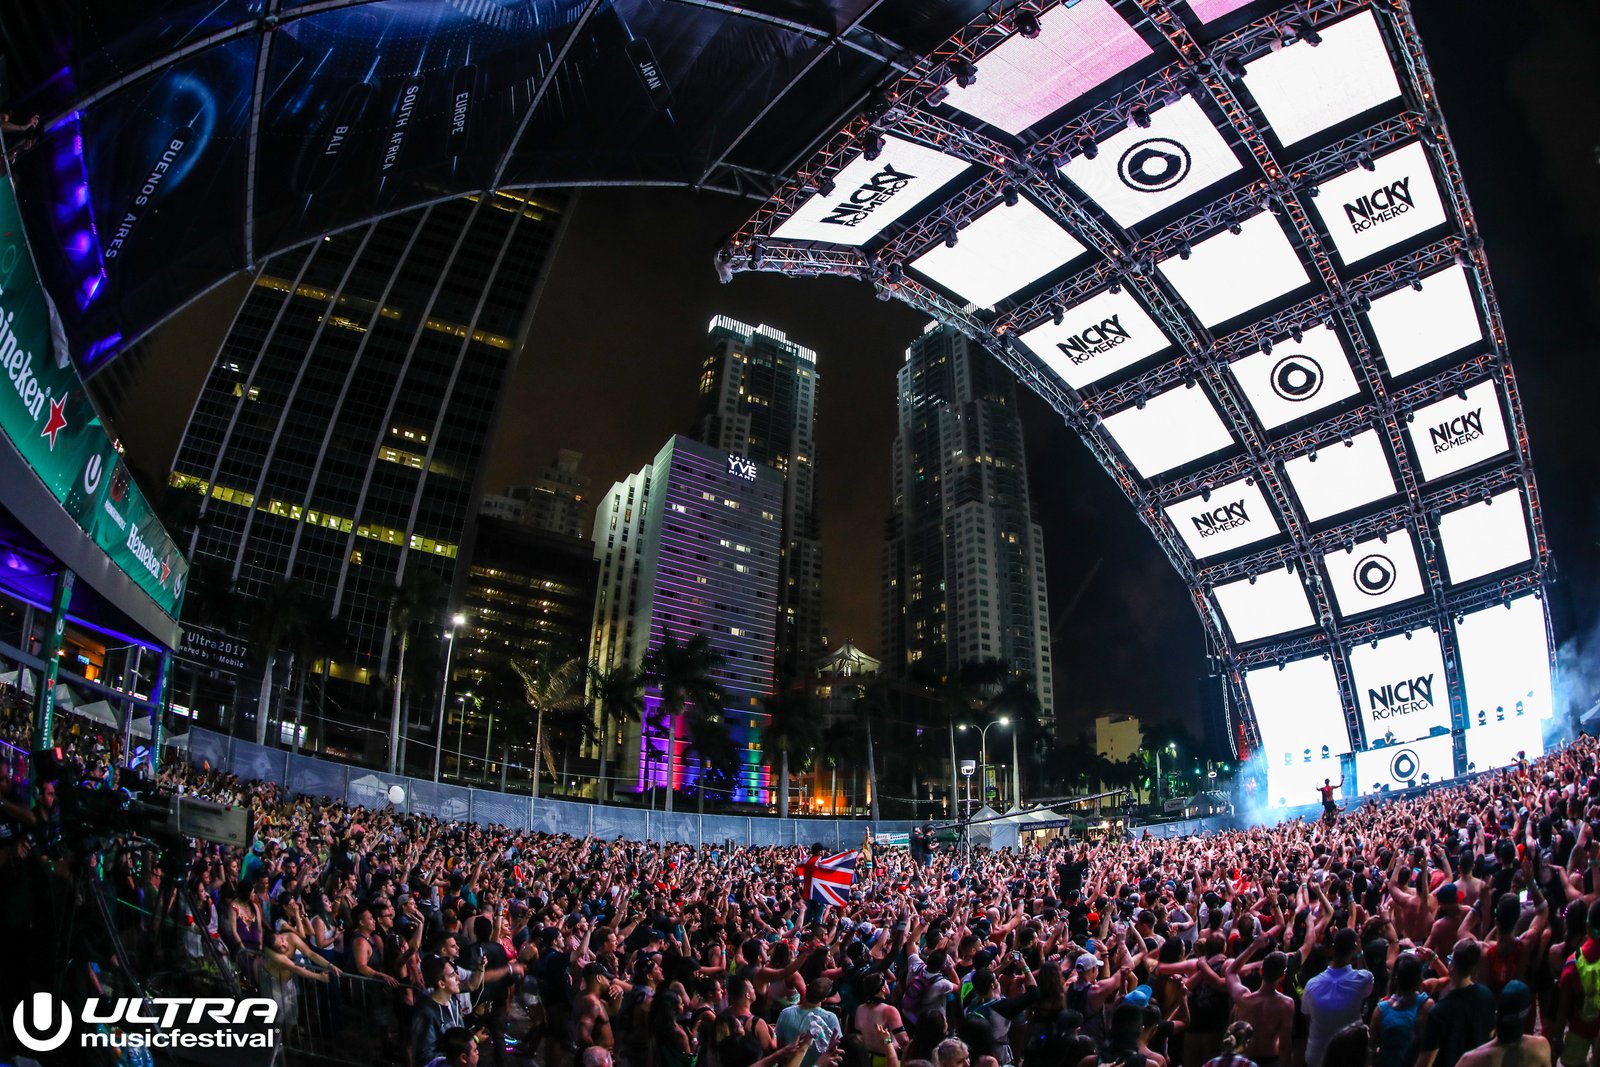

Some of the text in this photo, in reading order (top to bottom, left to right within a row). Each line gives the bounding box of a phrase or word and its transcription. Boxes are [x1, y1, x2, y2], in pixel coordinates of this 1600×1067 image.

[638, 60, 661, 90] JAPAN
[382, 85, 419, 171] SOUTH AFRICA
[451, 92, 469, 136] EUROPE
[325, 125, 349, 155] BALI
[106, 139, 184, 258] BUENOS AIRES
[819, 163, 918, 224] NICKY
[844, 180, 908, 227] ROMERO
[1343, 176, 1415, 224] NICKY
[1352, 203, 1409, 234] ROMERO
[1056, 314, 1132, 358] NICKY
[1070, 335, 1125, 365] ROMERO
[1429, 407, 1484, 445] NICKY
[1434, 430, 1479, 454] ROMERO
[728, 458, 757, 478] YVE
[728, 469, 755, 481] MIAMI
[729, 454, 756, 467] HOTEL
[1191, 499, 1251, 530] NICKY
[1199, 518, 1245, 538] ROMERO
[126, 522, 161, 579] Heineken
[1368, 673, 1434, 710] NICKY
[1372, 700, 1428, 721] ROMERO
